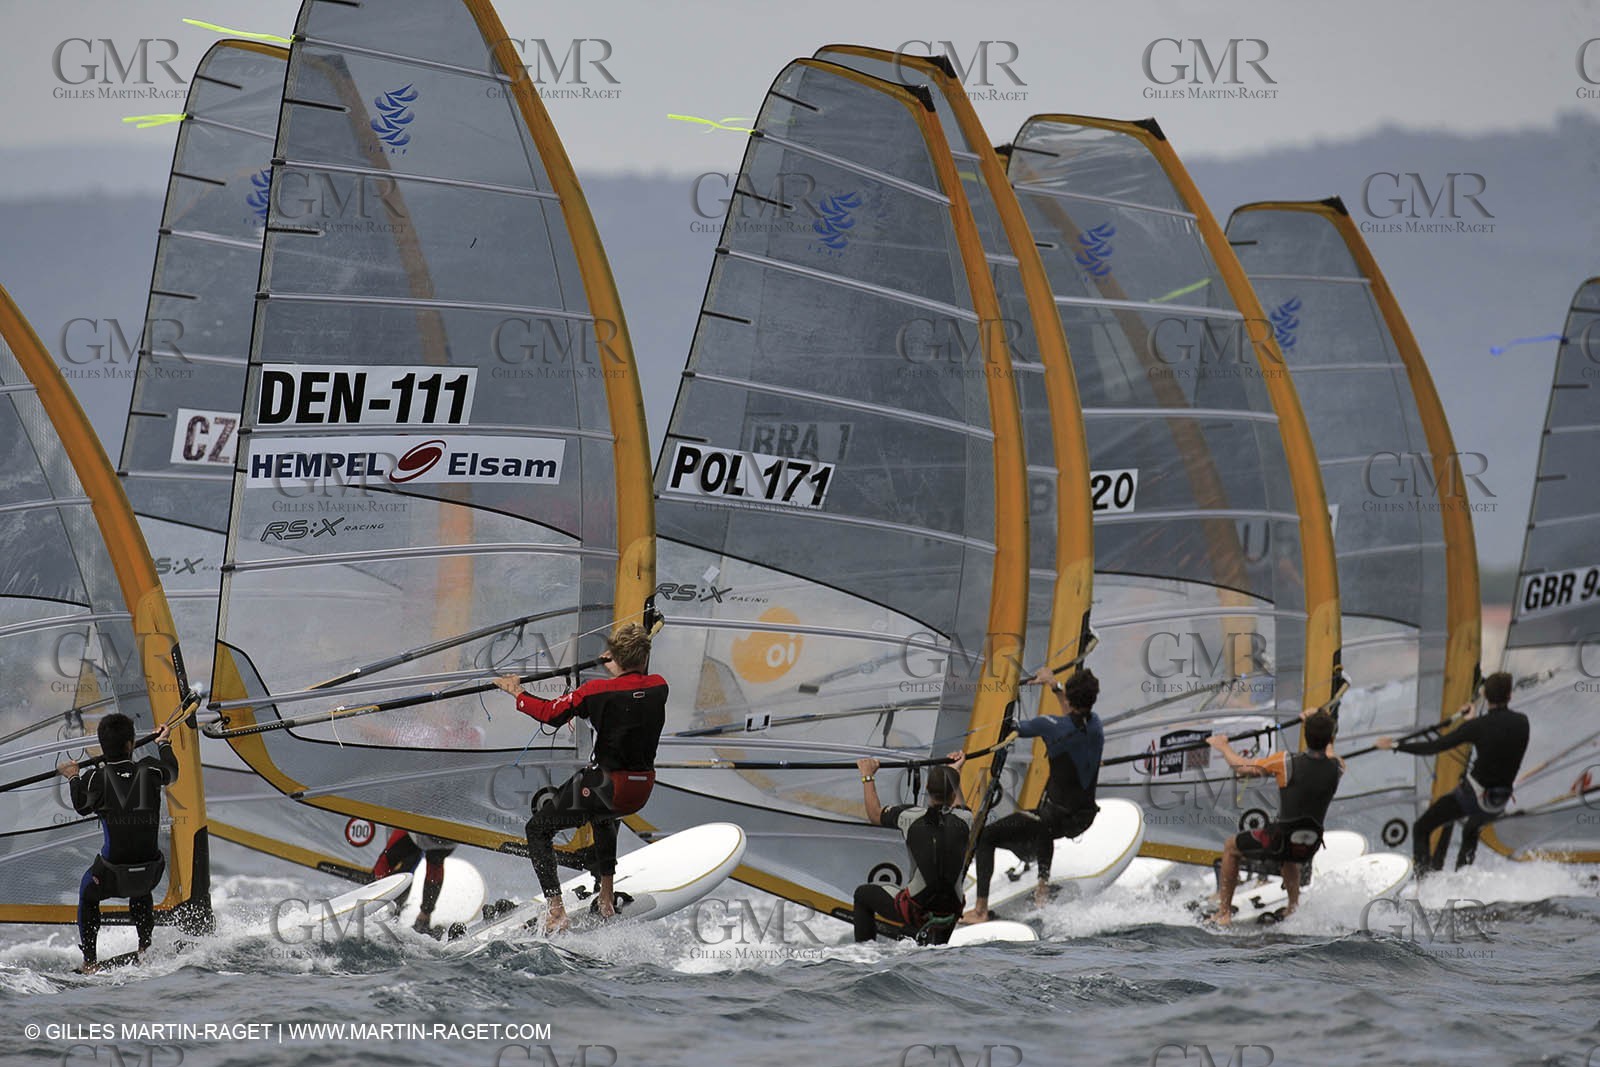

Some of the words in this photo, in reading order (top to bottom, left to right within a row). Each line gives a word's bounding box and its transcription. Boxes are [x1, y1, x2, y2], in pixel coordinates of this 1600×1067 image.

[258, 370, 470, 424] DEN-111
[182, 414, 238, 464] CZ
[251, 452, 384, 479] HEMPEL
[447, 452, 557, 479] Elsam
[670, 446, 744, 496] POL
[763, 460, 832, 506] 171
[344, 522, 385, 531] RACING
[155, 557, 204, 575] S:X
[1525, 573, 1577, 610] GBR
[1581, 568, 1600, 600] 9
[351, 824, 370, 839] 100
